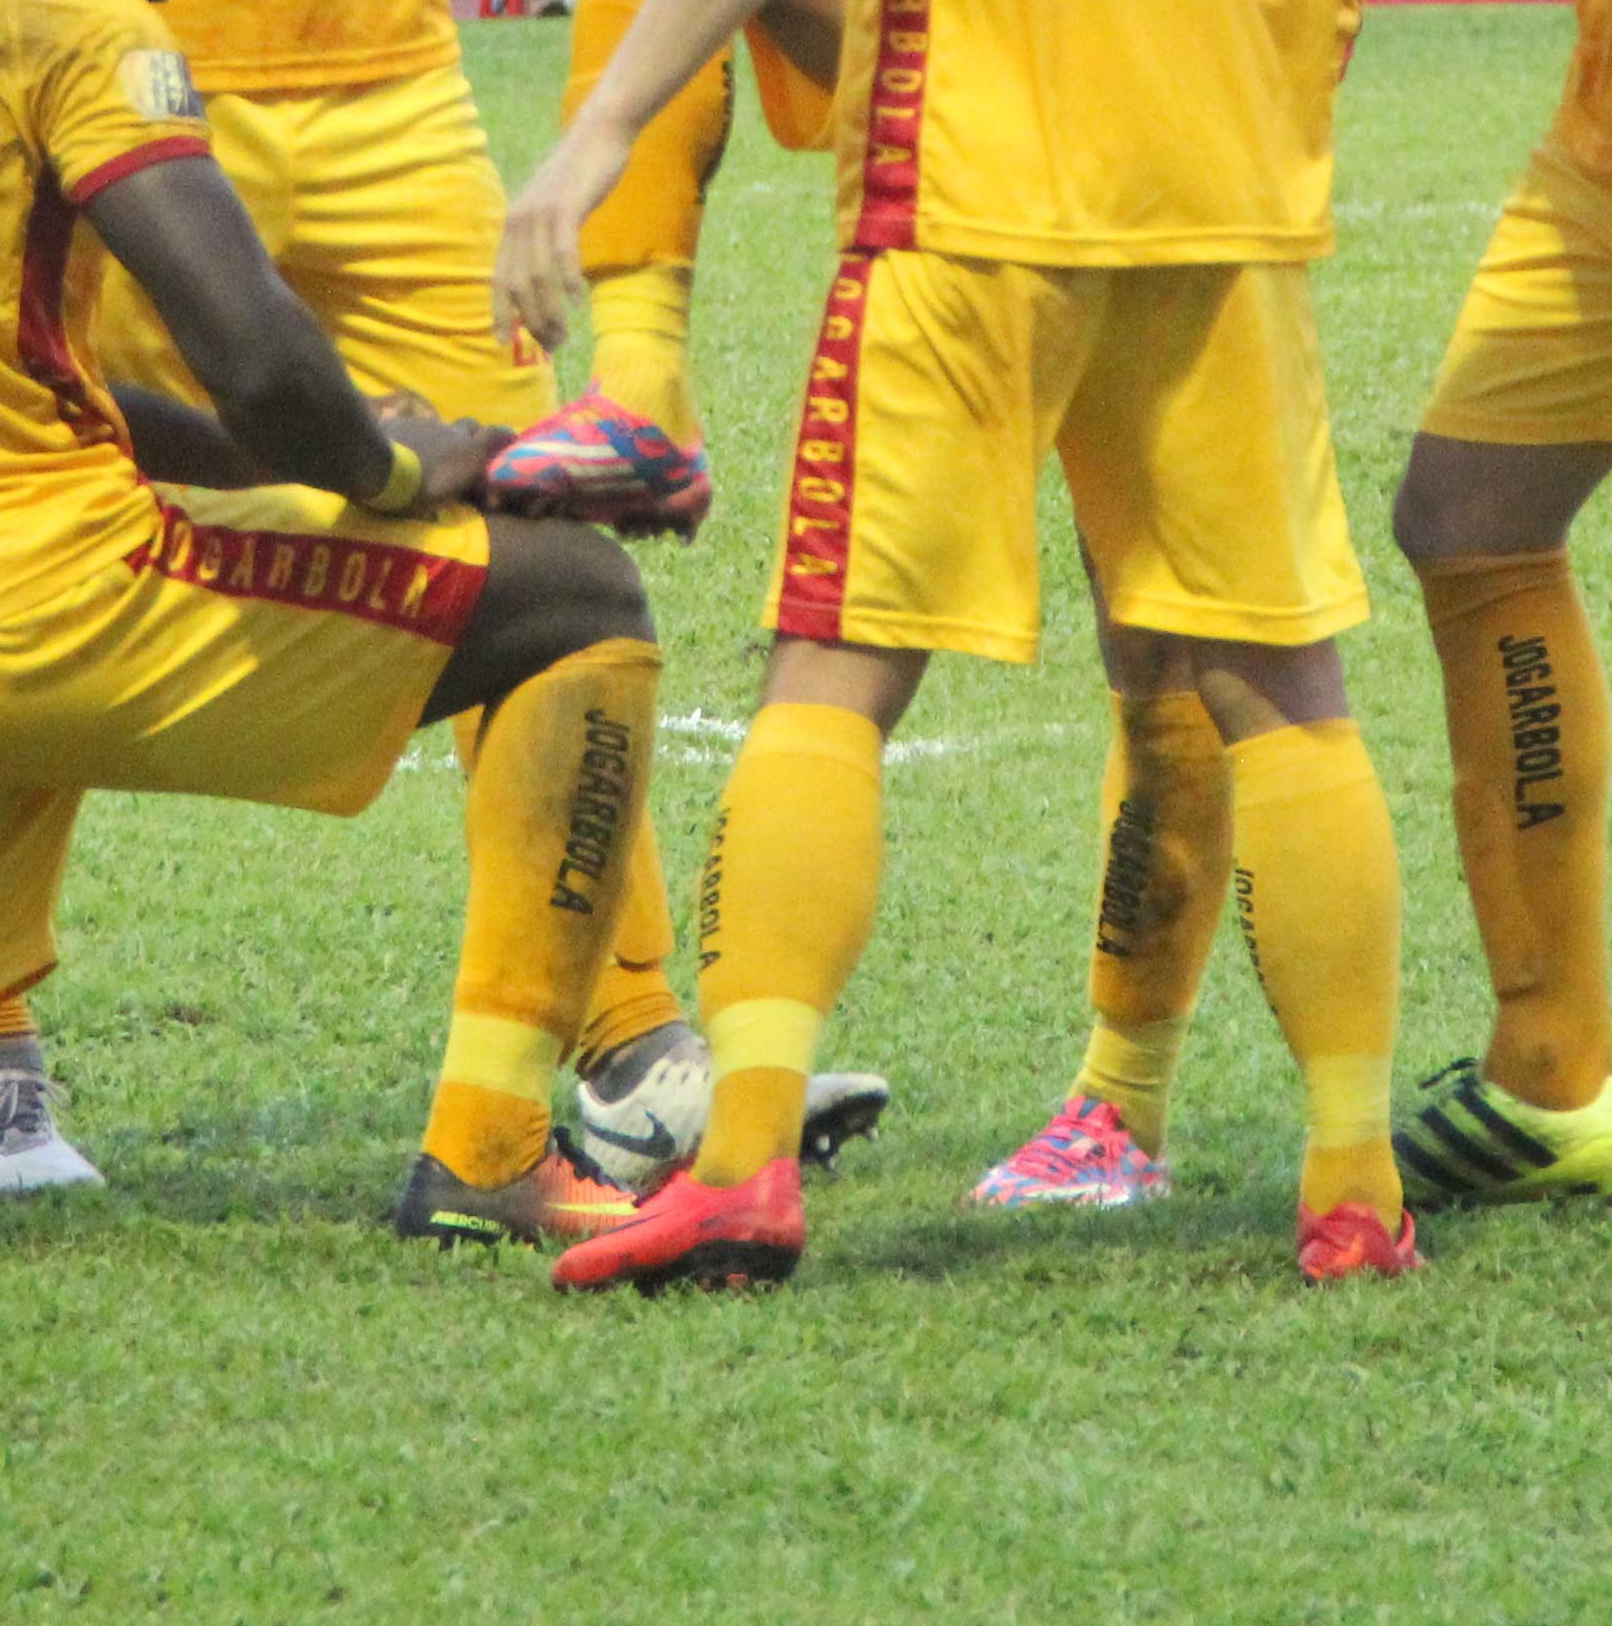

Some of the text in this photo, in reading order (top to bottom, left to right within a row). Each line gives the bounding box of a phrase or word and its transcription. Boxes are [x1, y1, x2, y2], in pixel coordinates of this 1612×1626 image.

[165, 518, 430, 618] OGARBOLA
[550, 707, 631, 915] JOGARBOLA
[1498, 634, 1566, 830] JOGARBOLA
